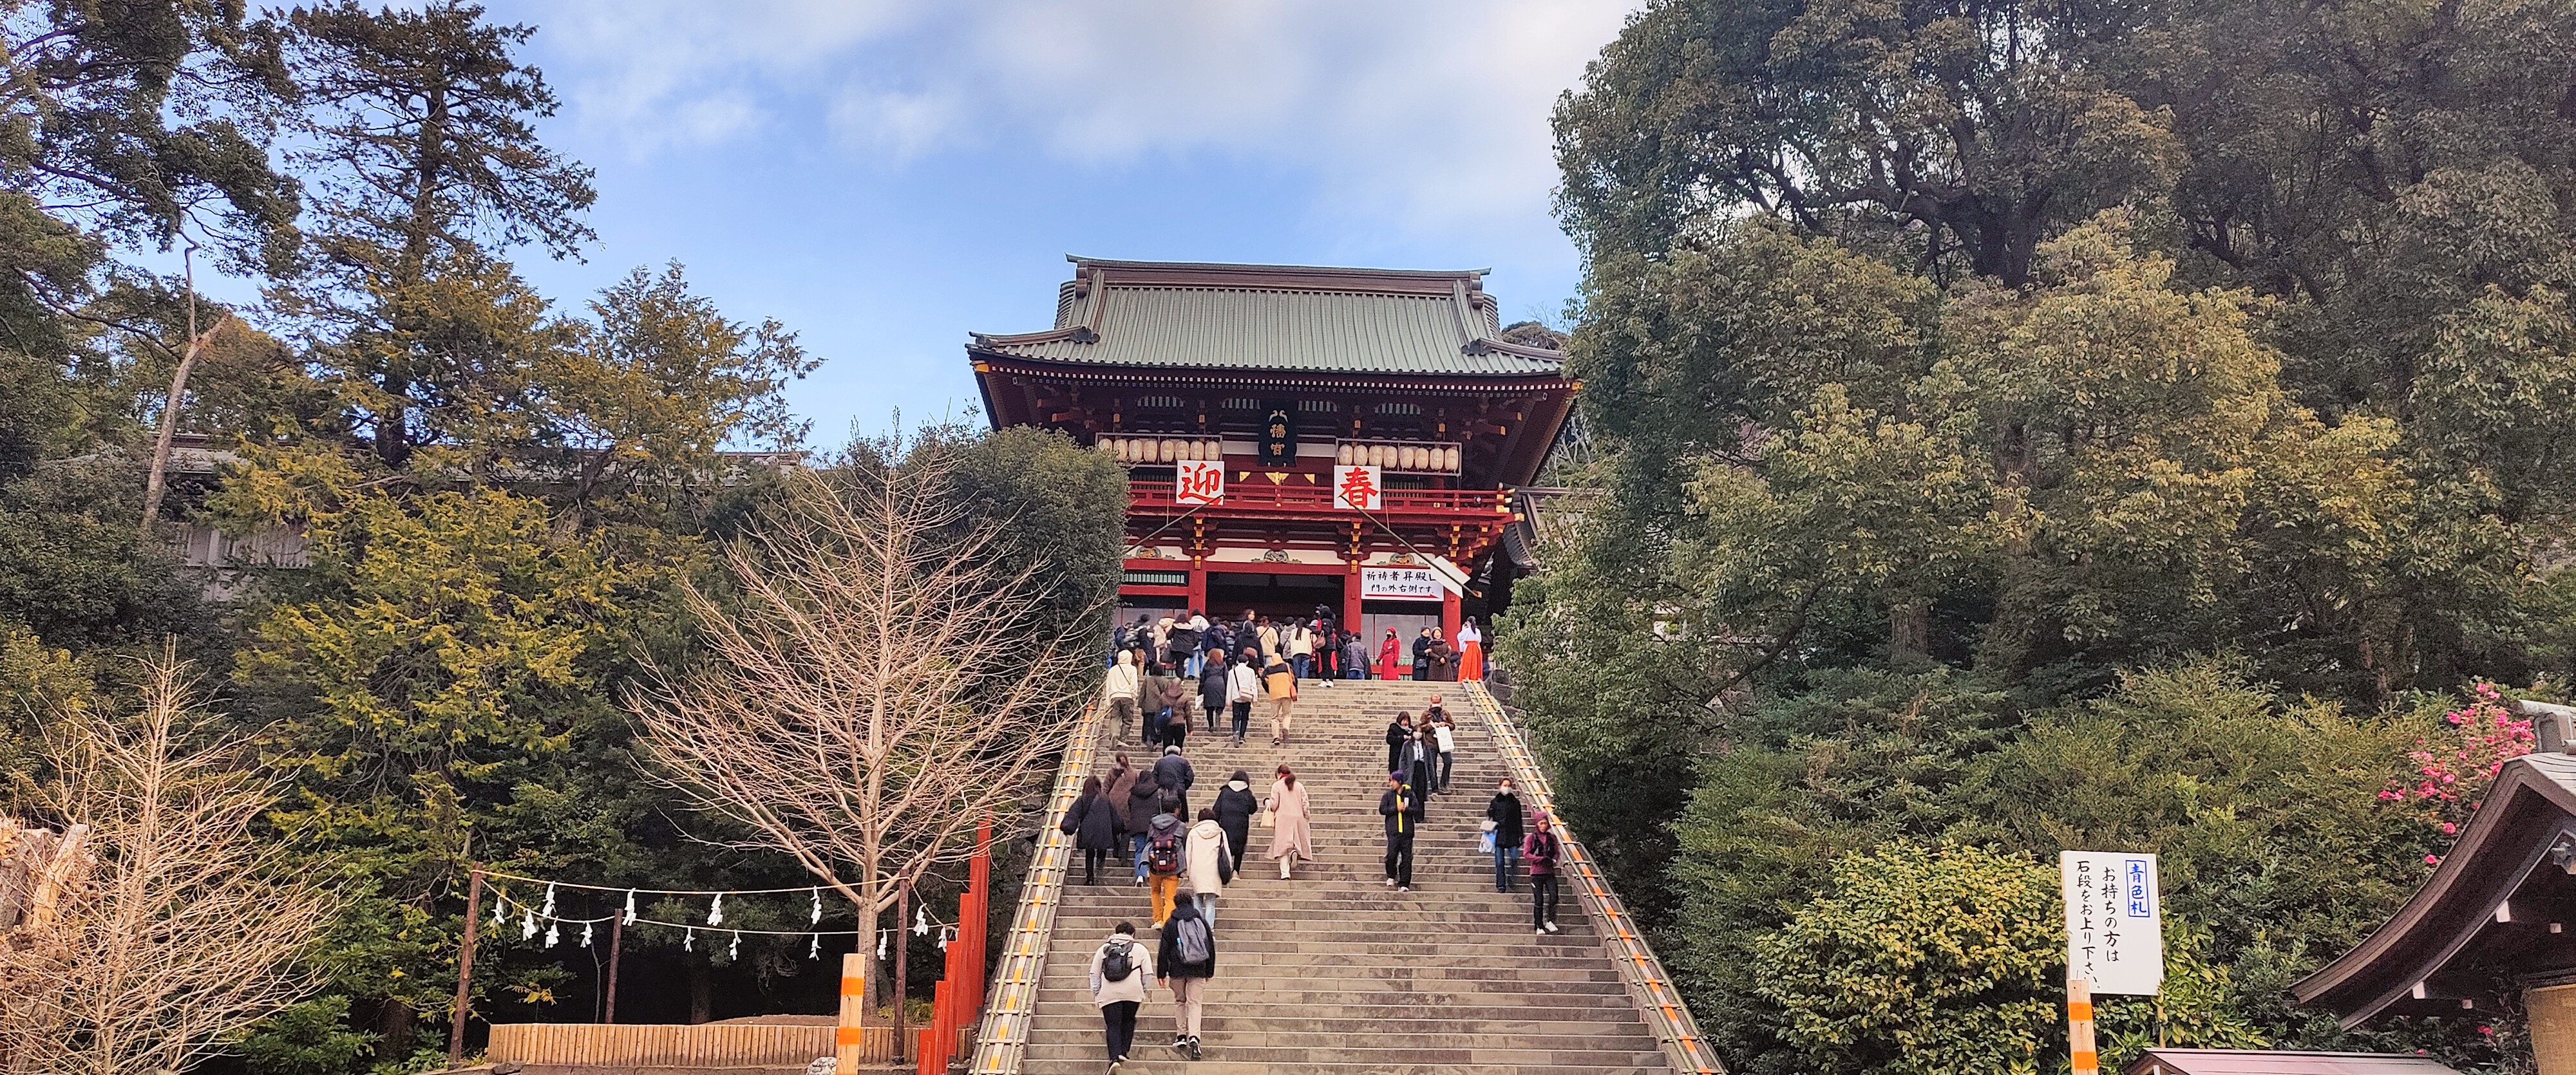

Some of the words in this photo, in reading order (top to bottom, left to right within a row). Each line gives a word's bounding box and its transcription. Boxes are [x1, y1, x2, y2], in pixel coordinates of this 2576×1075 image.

[1178, 462, 1222, 505] 迎
[1340, 467, 1379, 509] 春
[2129, 863, 2147, 914] 青色札
[2101, 866, 2121, 962] お持ちの方は
